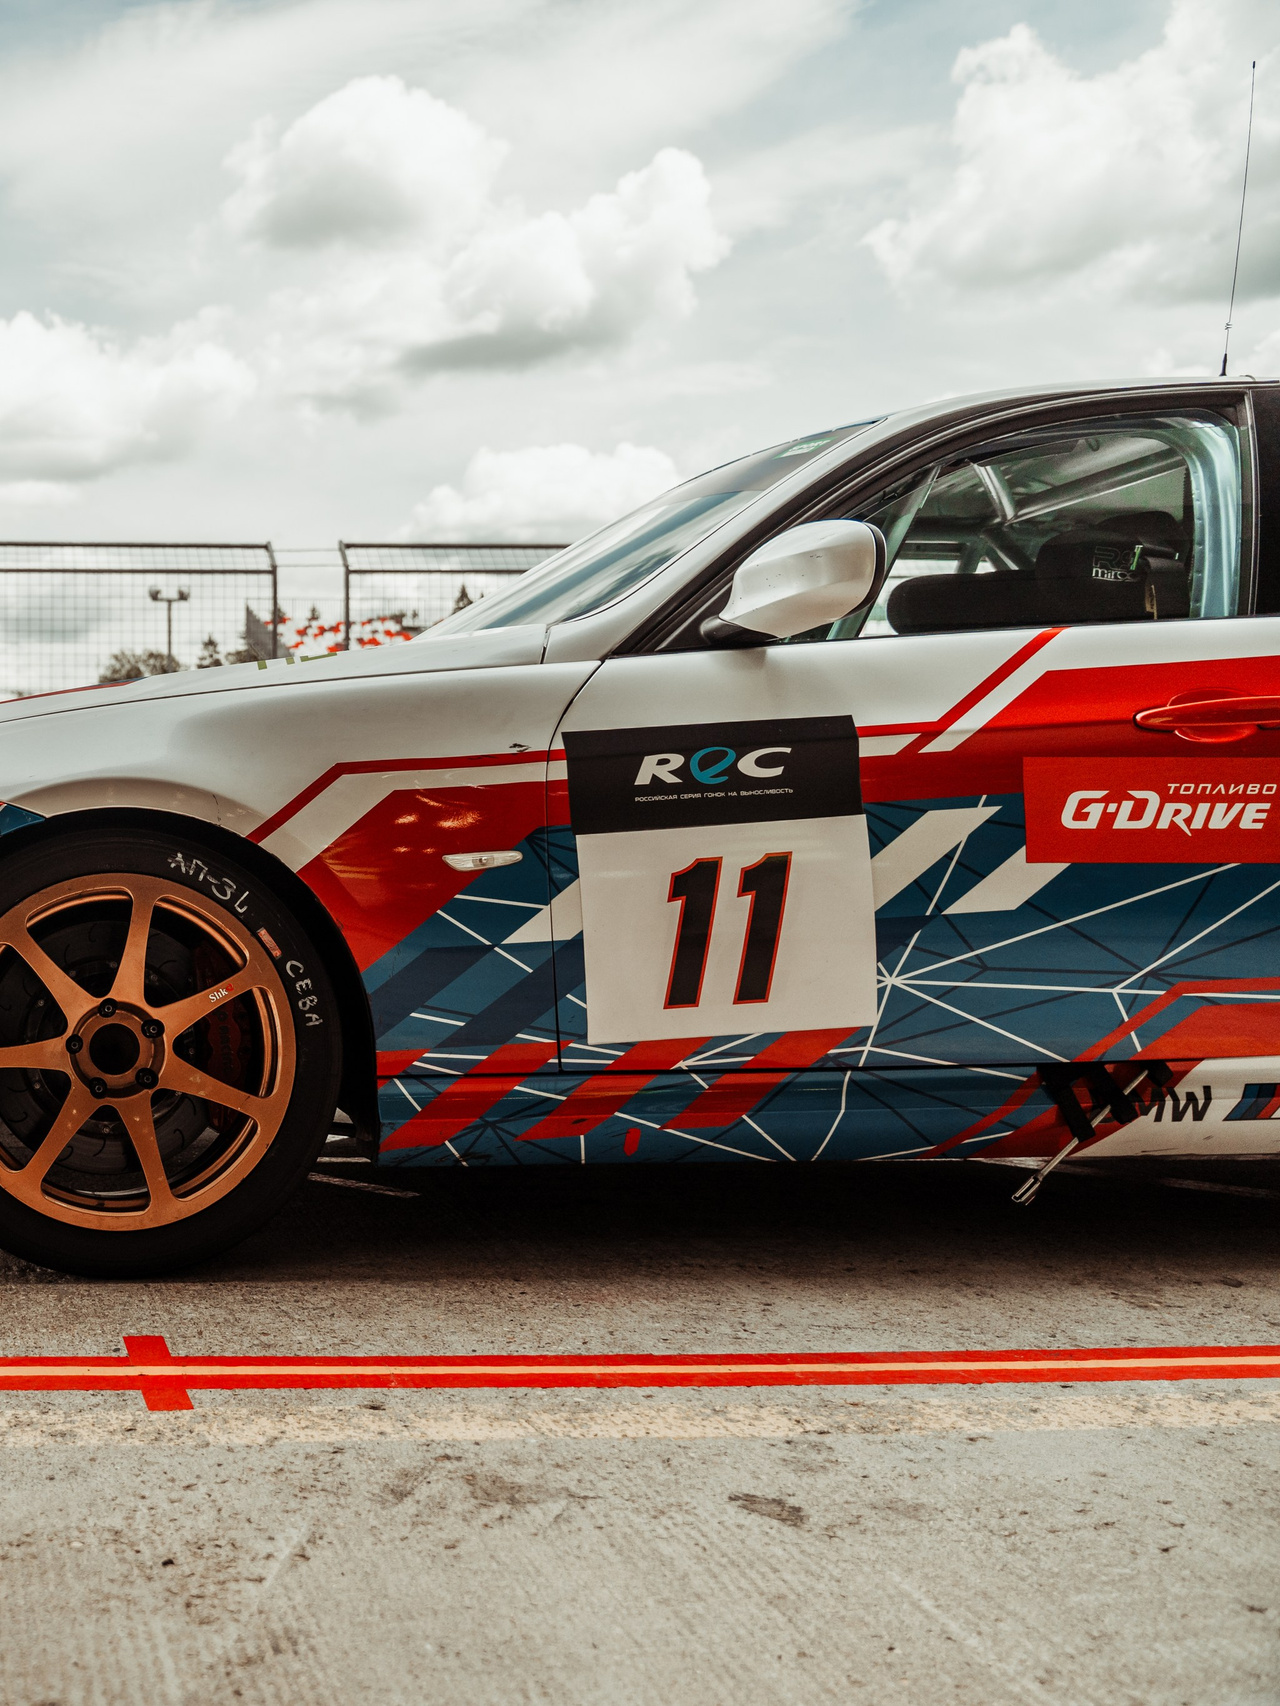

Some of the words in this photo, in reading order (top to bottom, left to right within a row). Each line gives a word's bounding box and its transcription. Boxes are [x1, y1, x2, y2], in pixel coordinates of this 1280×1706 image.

[634, 794, 678, 802] РОССИЙСКАЯ
[680, 792, 702, 800] СЕРИЯ
[740, 787, 794, 797] ВЫНОСЛИВОСТЬ
[1167, 783, 1278, 795] ТОПЛИВО
[663, 851, 793, 1009] 11
